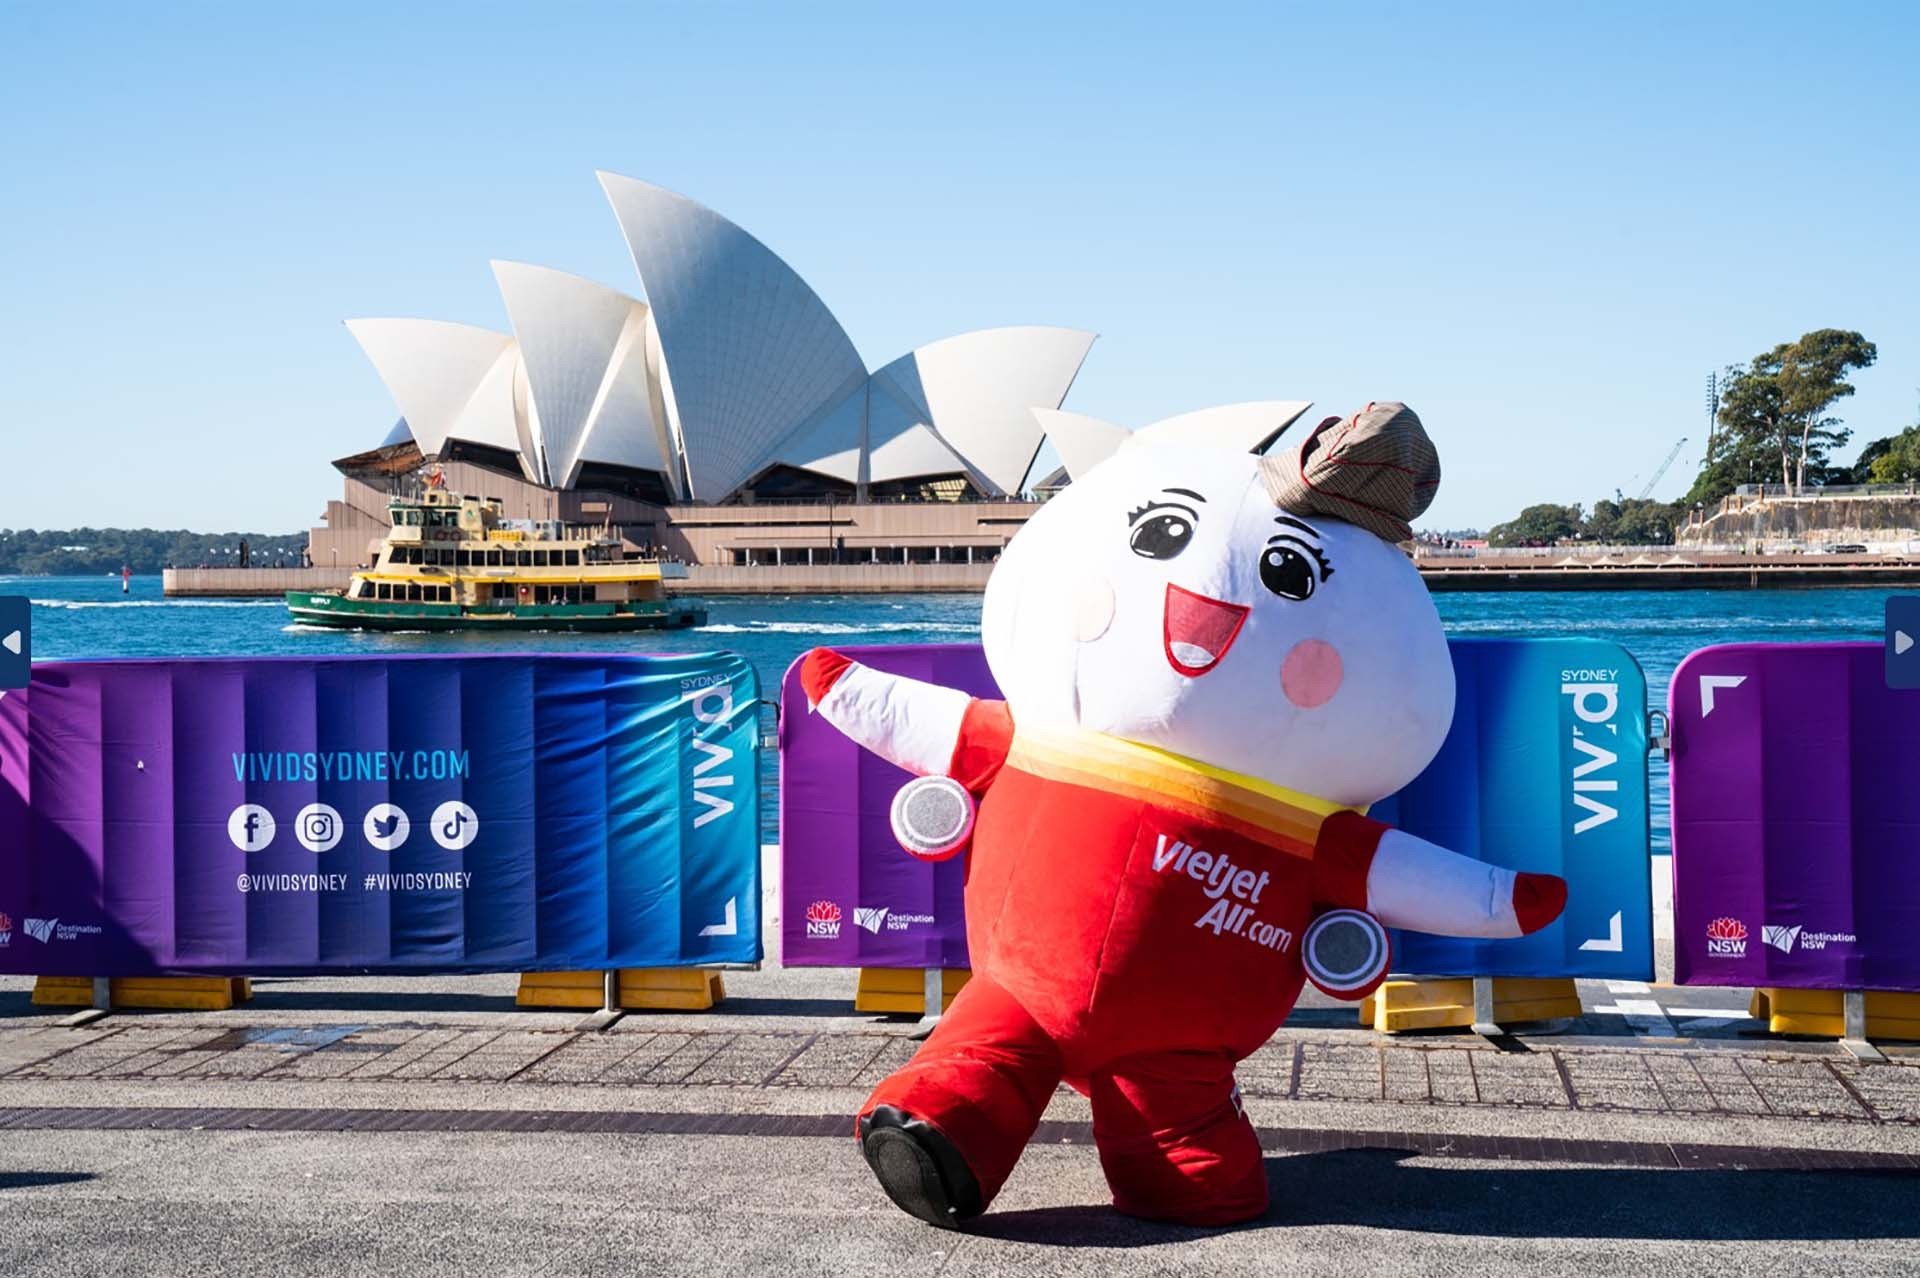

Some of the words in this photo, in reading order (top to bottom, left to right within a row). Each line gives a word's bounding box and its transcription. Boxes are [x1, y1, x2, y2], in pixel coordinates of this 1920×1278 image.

[680, 673, 733, 689] SYDNEY
[1561, 669, 1618, 681] SYDNEY
[232, 750, 470, 782] VIVIDSYDNEY.COM
[236, 873, 347, 892] @VIVIDSYDNEY
[364, 872, 472, 891] #VIVIDSYDNEY
[886, 913, 935, 923] Destination
[56, 924, 103, 934] Destination
[807, 922, 841, 935] NSW
[887, 922, 909, 931] NSW
[1801, 931, 1857, 942] Destination
[1708, 940, 1747, 953] NSW
[1801, 940, 1826, 949] NSW
